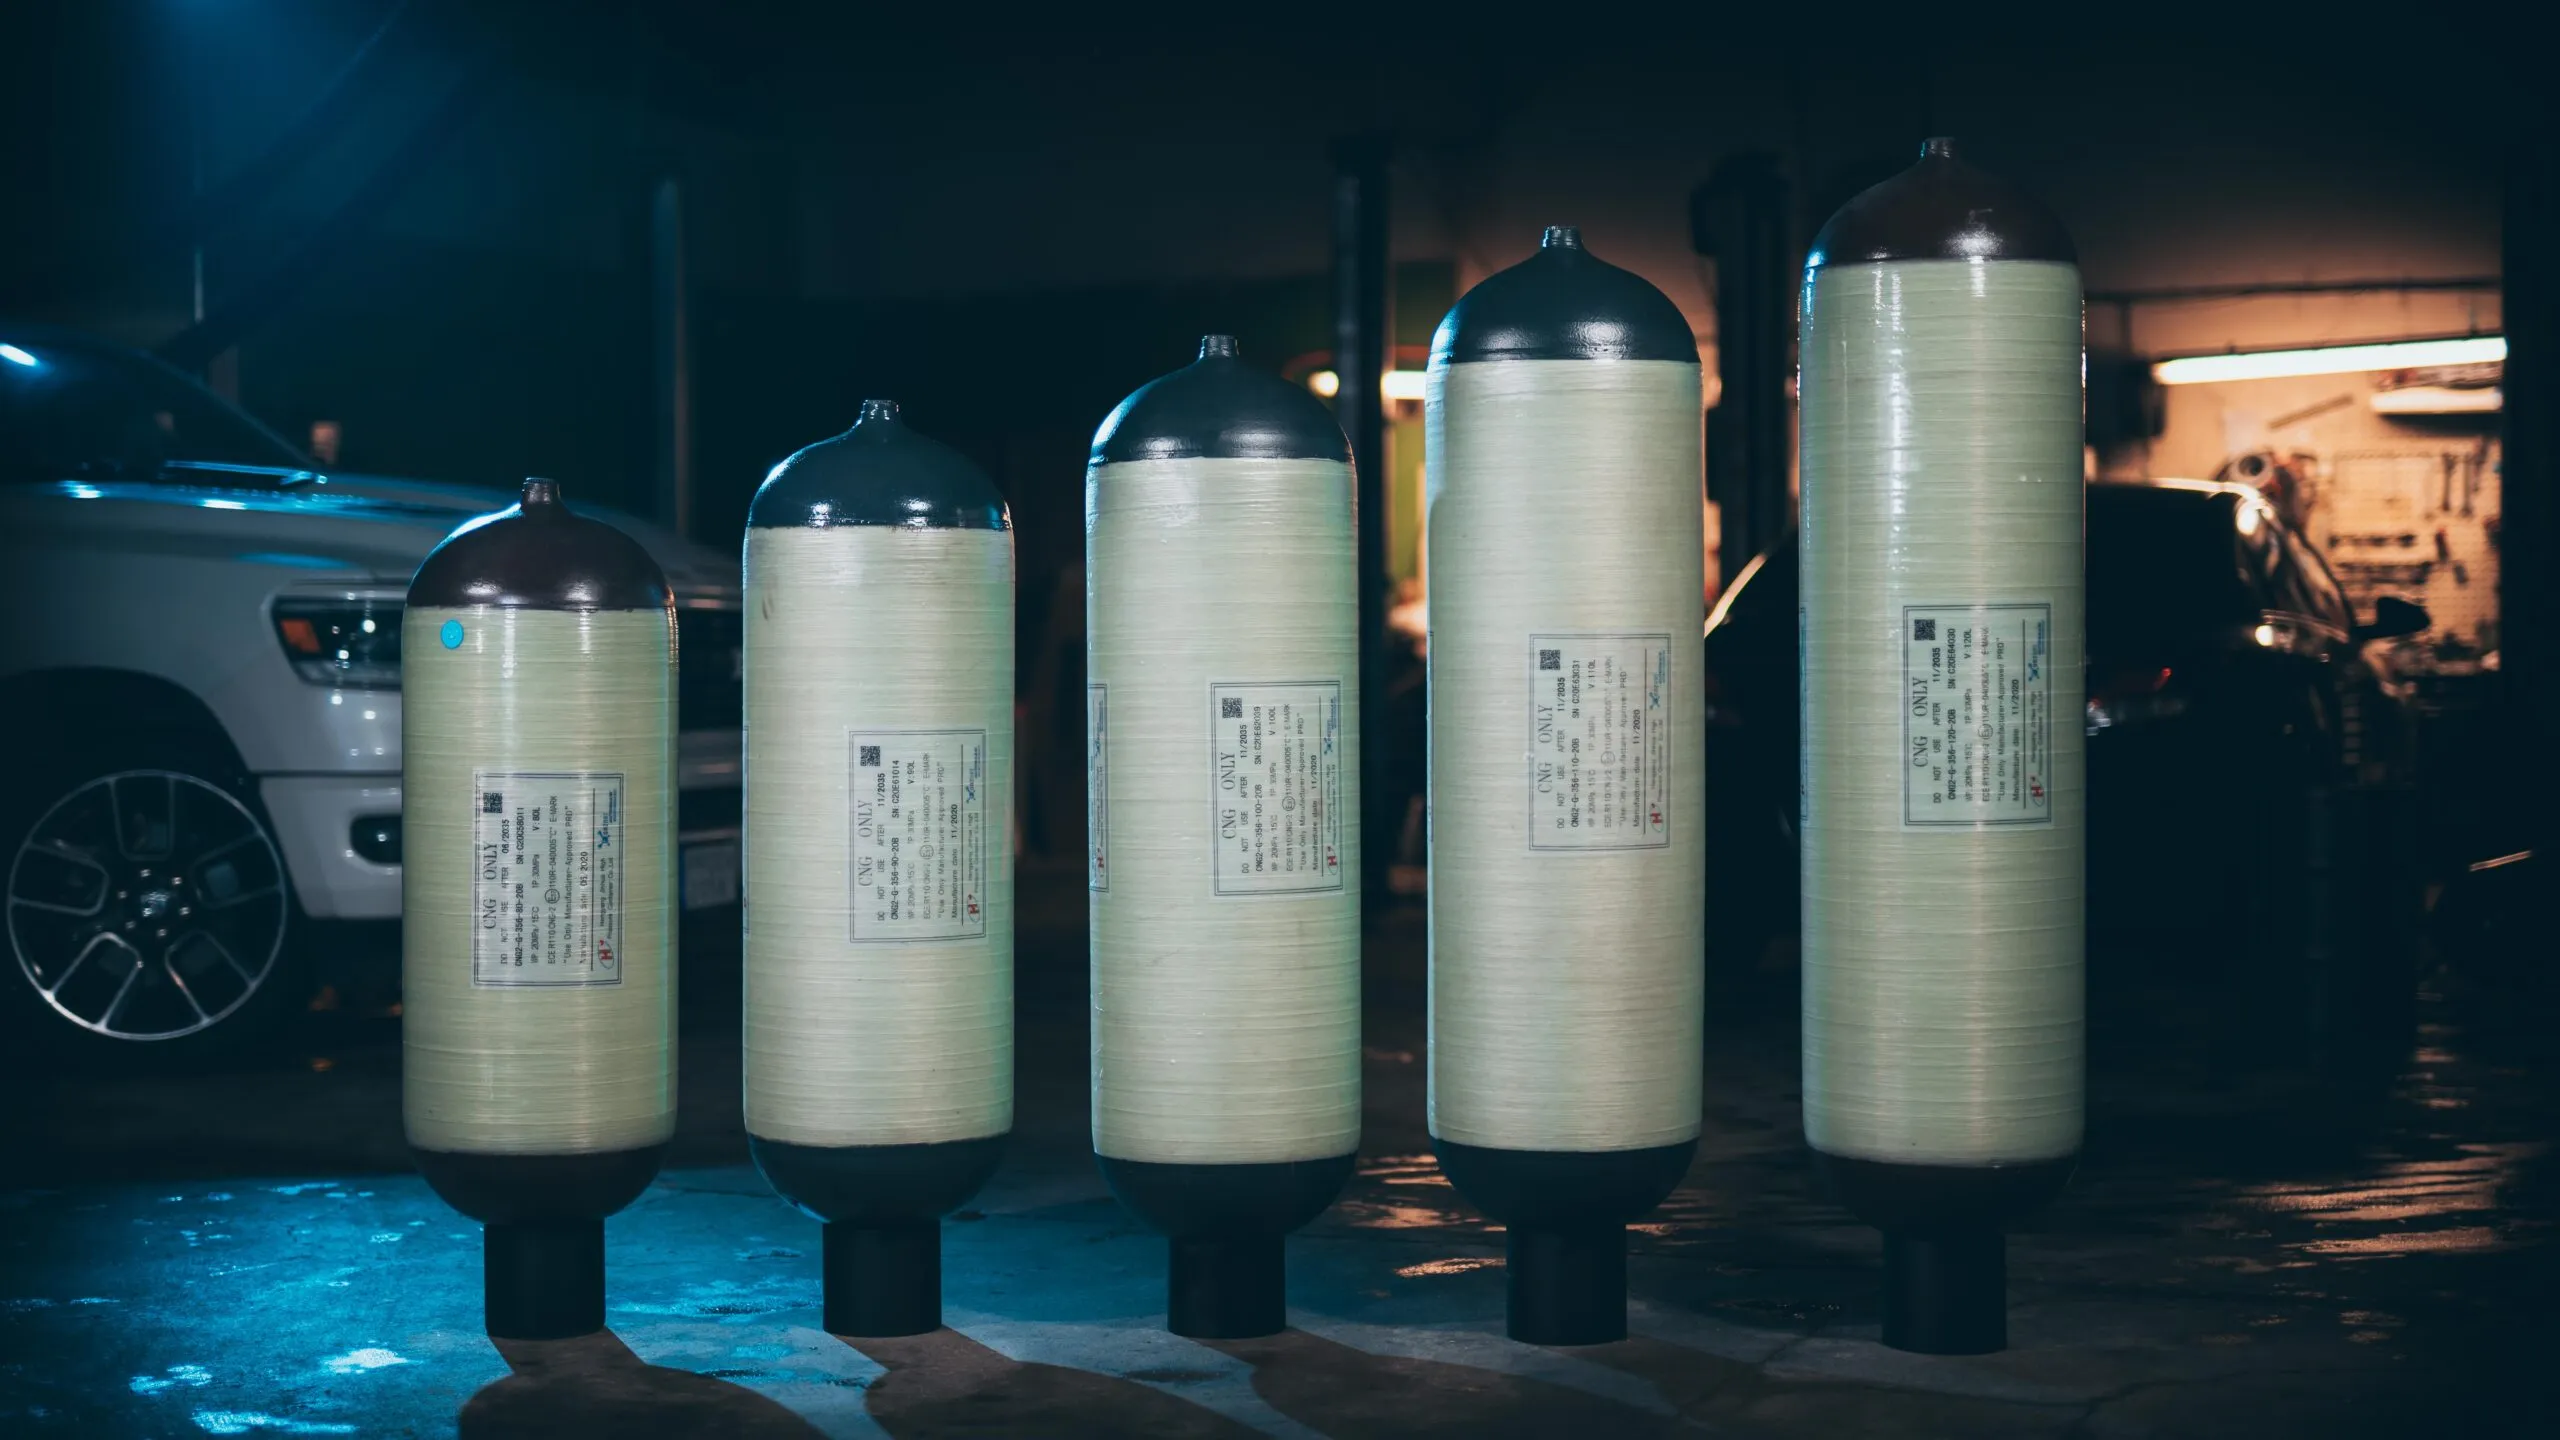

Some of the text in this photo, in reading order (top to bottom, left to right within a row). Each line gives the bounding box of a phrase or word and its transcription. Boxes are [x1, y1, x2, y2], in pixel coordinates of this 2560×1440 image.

[1913, 676, 1927, 767] CNG ONLY
[1933, 702, 1941, 725] AFTER
[1538, 704, 1552, 793] CNG ONLY
[1557, 677, 1565, 828] DO NOT USE AFTER 11/2035
[1933, 739, 1941, 752] USE
[1933, 766, 1941, 781] NOT
[1997, 759, 2005, 776] Only
[877, 773, 885, 807] 11/2035
[1221, 752, 1236, 839] CNG ONLY
[1934, 793, 1941, 803] DO
[1255, 784, 1263, 872] CNG2-G-356-100-20B
[858, 800, 872, 886] CNG ONLY
[877, 859, 885, 872] USE
[891, 838, 899, 920] CNG2-G-356-90-20B
[1242, 863, 1249, 873] DO
[483, 841, 497, 929] CNG ONLY
[937, 878, 945, 895] Only
[564, 923, 573, 940] Only
